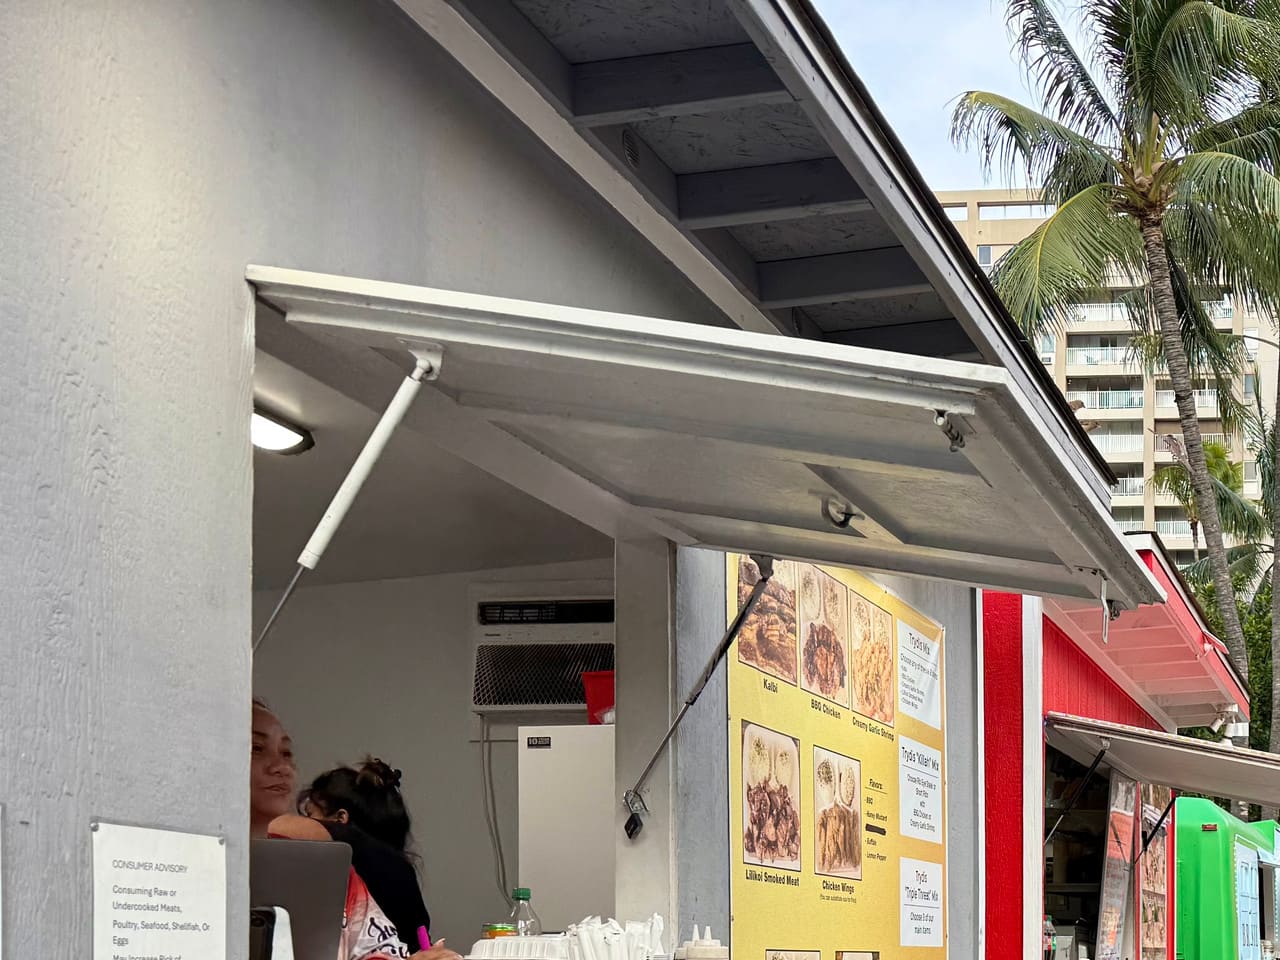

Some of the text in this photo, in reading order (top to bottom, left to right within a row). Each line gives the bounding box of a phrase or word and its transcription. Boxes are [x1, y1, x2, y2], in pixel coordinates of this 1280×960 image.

[763, 678, 778, 693] Kalbi
[811, 698, 841, 719] BBQ Chicken
[852, 717, 894, 741] Creamy Garlic Shrimp
[112, 859, 189, 873] CONSUMER ADVISORY
[764, 871, 785, 885] Smoked
[786, 875, 799, 886] Meat
[112, 884, 153, 897] Consuming
[153, 887, 168, 896] Raw
[822, 880, 855, 894] Chicken Wings
[112, 900, 182, 913] Undercooked Meats,
[112, 919, 139, 931] Poultry,
[140, 920, 171, 931] Seafood,
[202, 922, 210, 931] Or
[112, 935, 129, 946] Eggs
